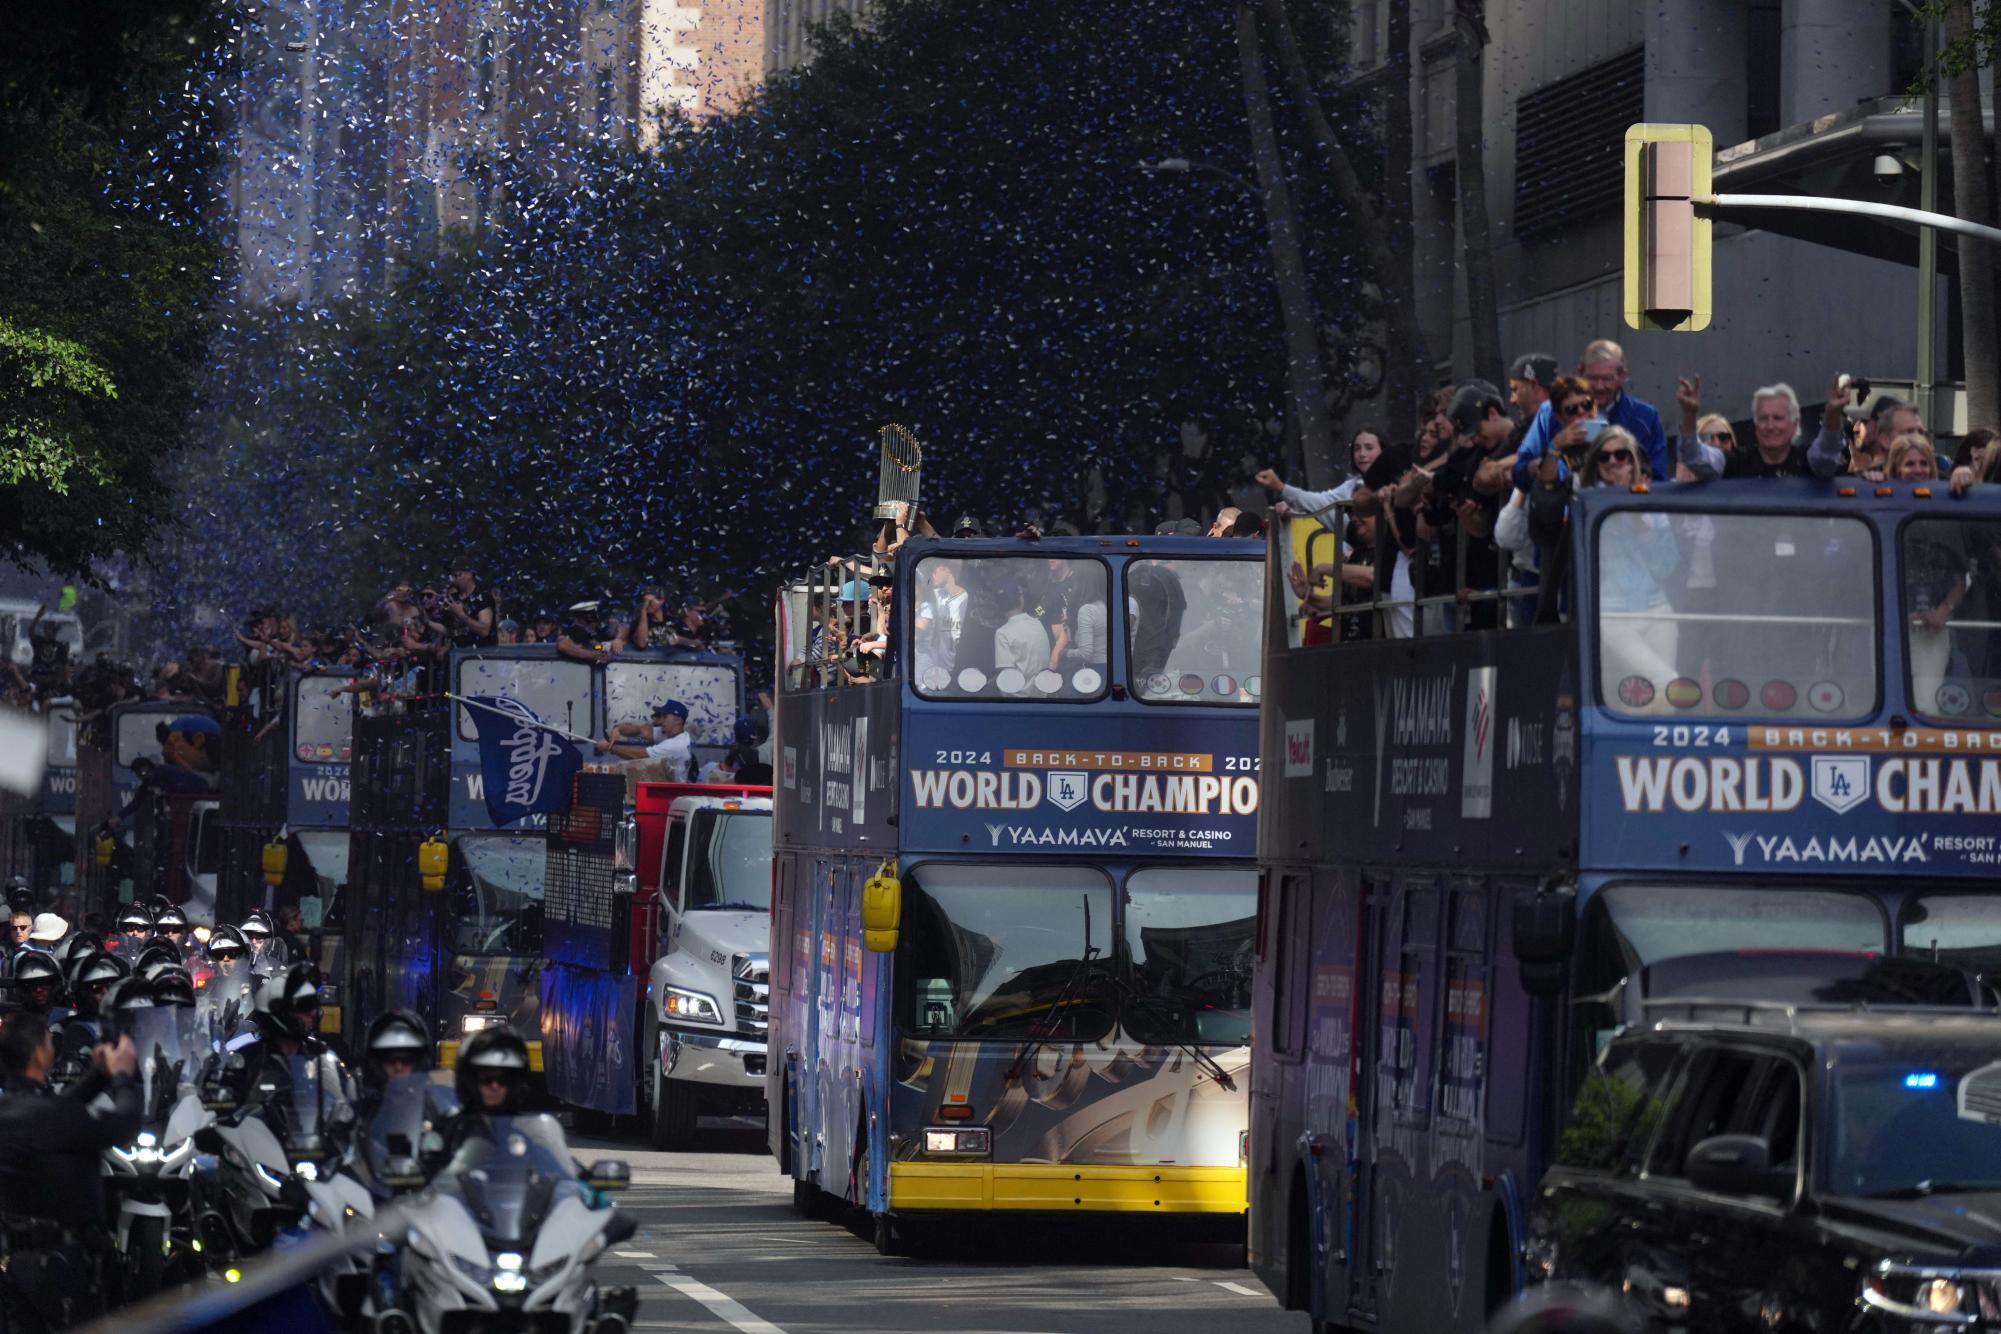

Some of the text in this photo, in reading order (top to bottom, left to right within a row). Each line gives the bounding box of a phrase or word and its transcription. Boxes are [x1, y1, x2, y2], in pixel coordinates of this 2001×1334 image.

[1653, 726, 1730, 747] 2024
[936, 750, 992, 765] 2024
[1016, 753, 1201, 768] BACK-TO-BACK
[1615, 755, 1804, 813] WORLD
[1830, 766, 1851, 796] LA
[912, 769, 1042, 810] WORLD
[1059, 778, 1075, 800] LA
[1092, 773, 1259, 816] CHAMPIO
[1132, 829, 1177, 839] RESORT
[1178, 830, 1187, 840] &
[1189, 830, 1232, 841] CASINO
[1934, 836, 1995, 850] RESORT
[1157, 840, 1176, 848] SAN
[1177, 840, 1213, 849] MANUEL
[1969, 852, 1994, 863] SAN
